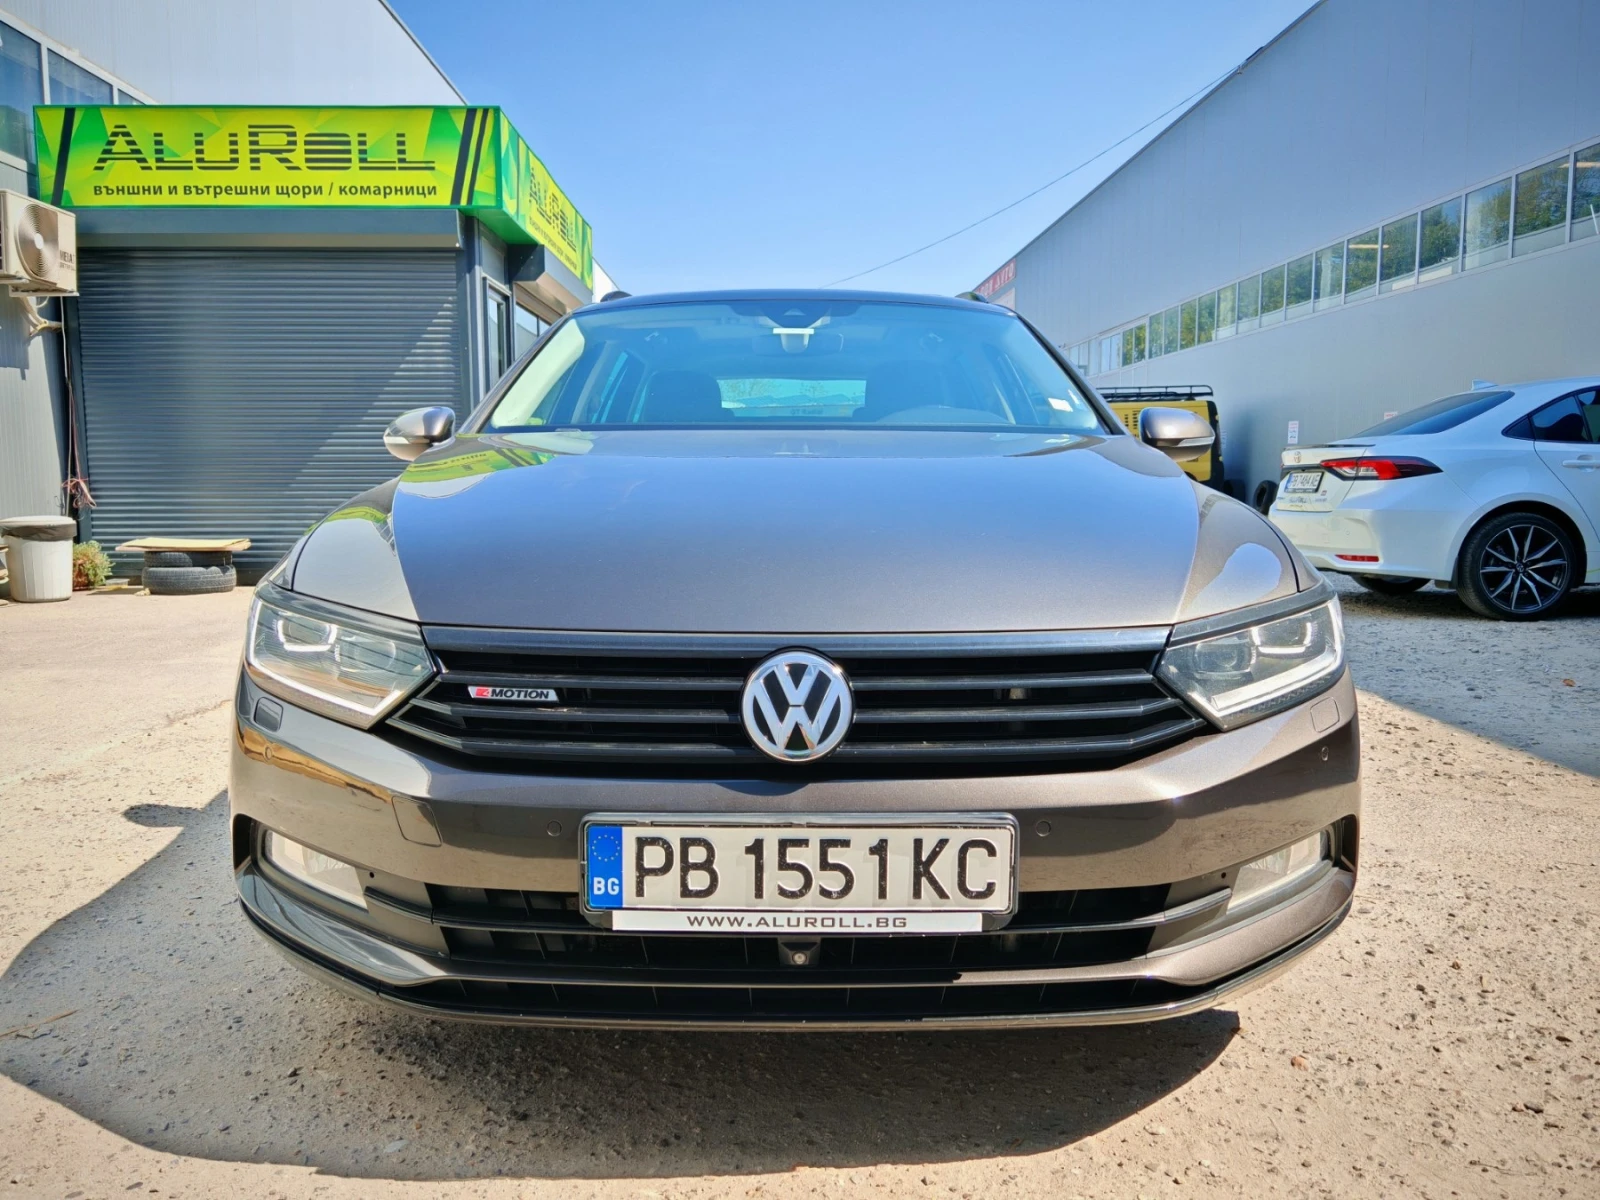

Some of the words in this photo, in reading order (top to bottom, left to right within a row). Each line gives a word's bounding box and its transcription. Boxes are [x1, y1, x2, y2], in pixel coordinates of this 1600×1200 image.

[93, 125, 435, 171] ALUROLL
[93, 185, 163, 196] външни
[168, 185, 178, 196] и
[183, 185, 271, 198] вътрешни
[276, 185, 323, 198] щори
[339, 185, 437, 198] комарници
[635, 836, 719, 898] PB
[745, 838, 888, 899] 1551
[912, 838, 997, 899] KC
[593, 877, 620, 895] BG
[687, 915, 907, 928] WWW.ALUROLL.BG
